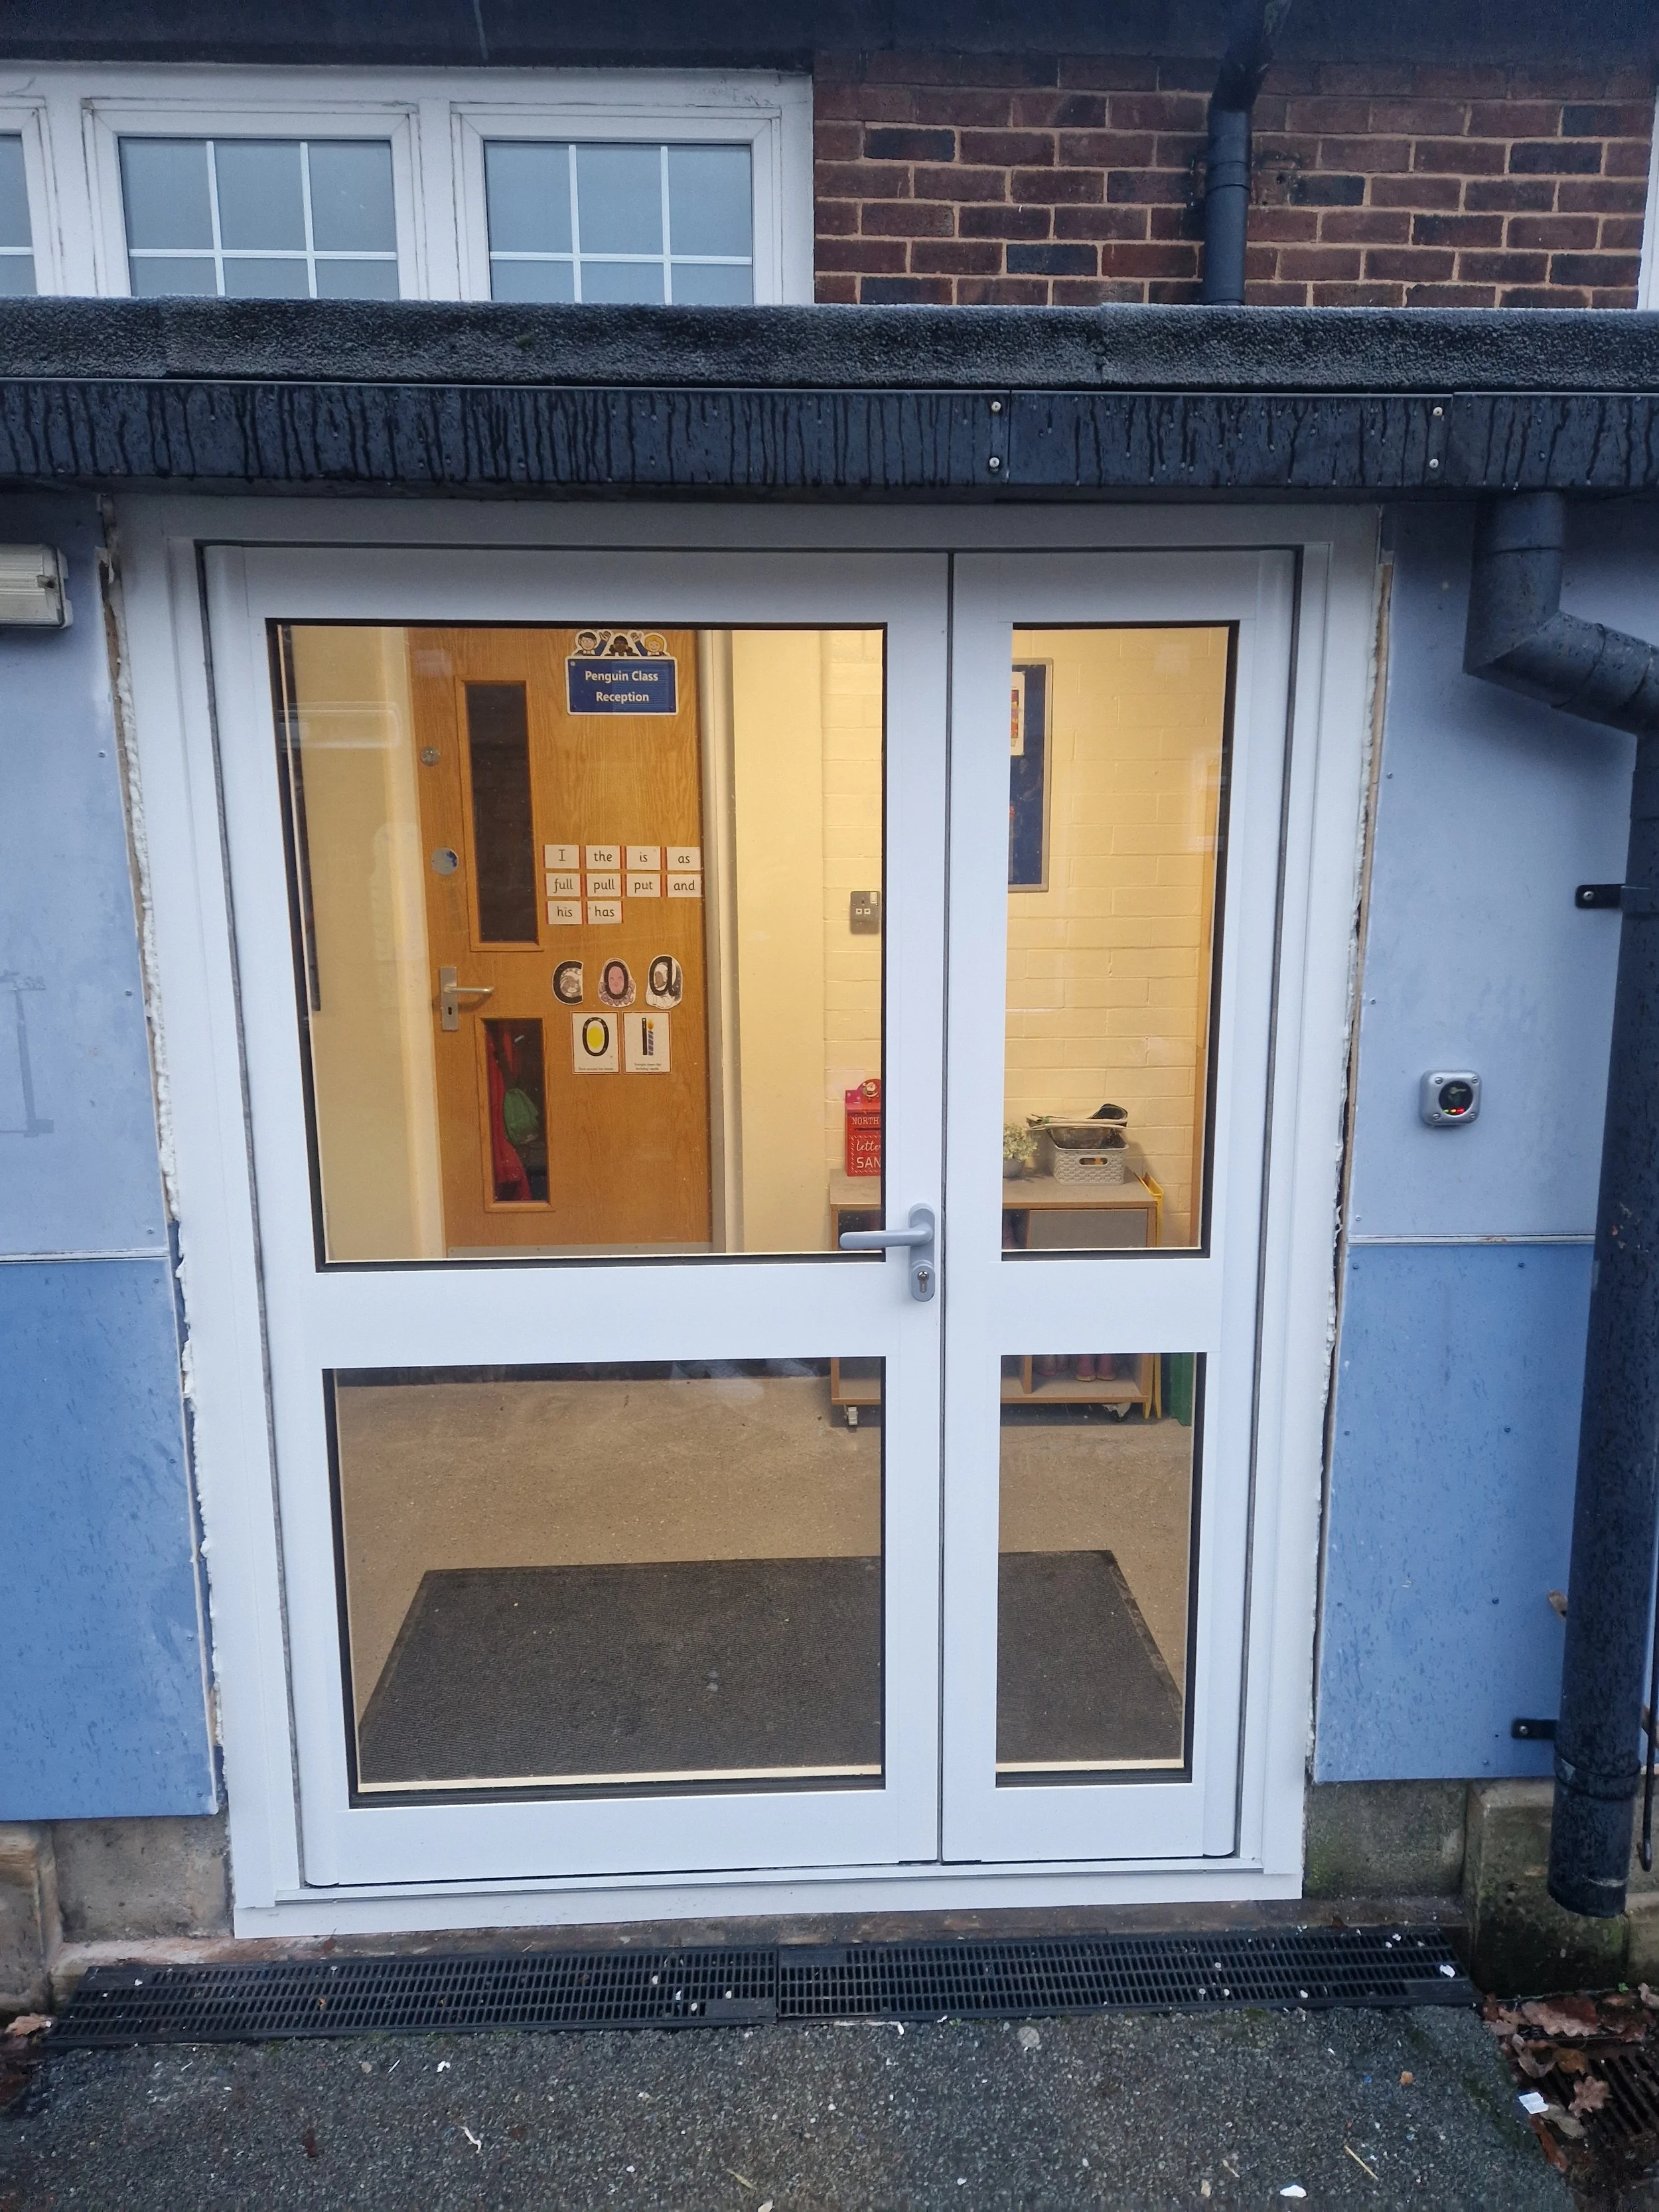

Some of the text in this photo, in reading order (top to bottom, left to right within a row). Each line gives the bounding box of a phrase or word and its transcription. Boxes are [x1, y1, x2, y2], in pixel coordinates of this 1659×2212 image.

[585, 670, 659, 684] Penguin Class
[596, 692, 650, 704] Reception
[558, 849, 690, 864] I the is as
[553, 878, 695, 894] full pull put and
[557, 906, 614, 917] his has
